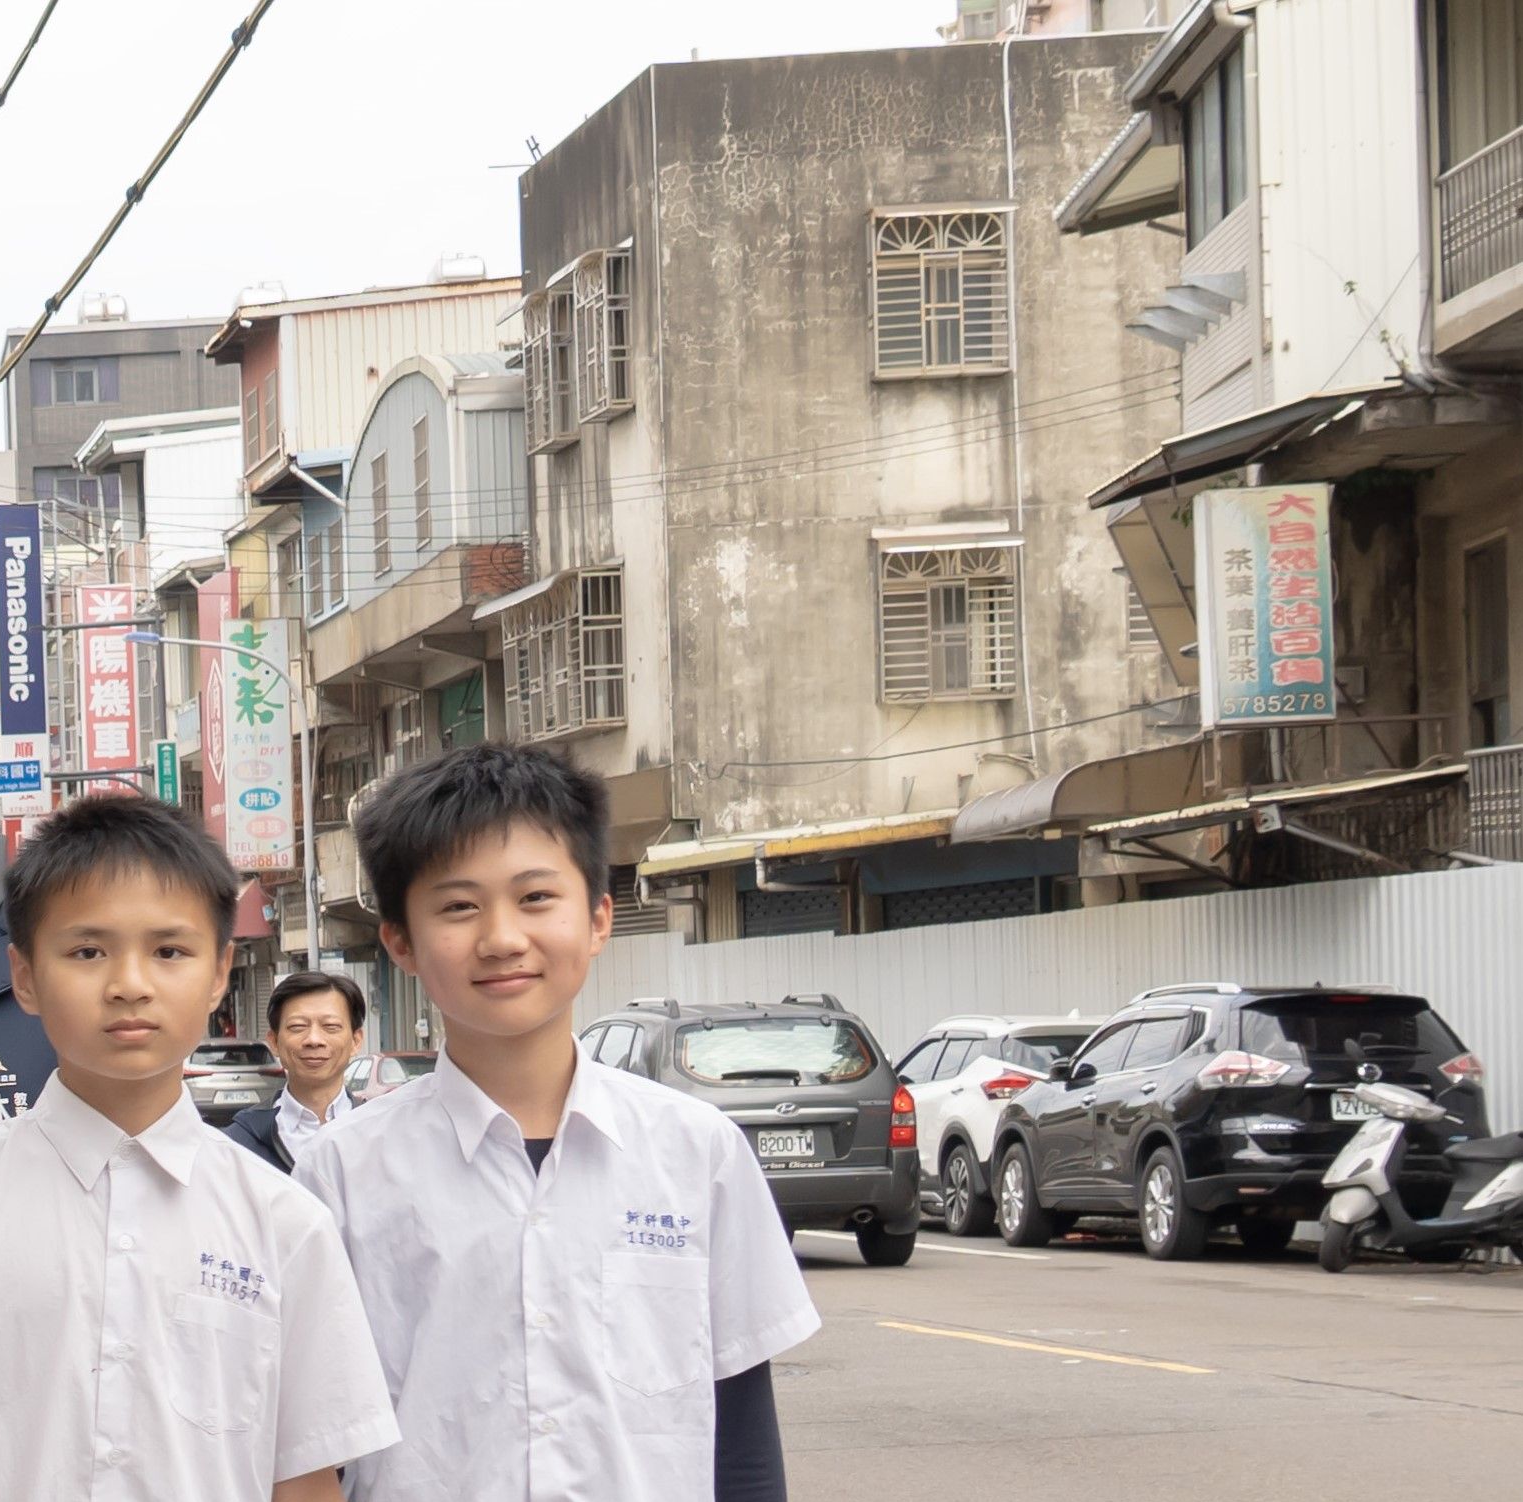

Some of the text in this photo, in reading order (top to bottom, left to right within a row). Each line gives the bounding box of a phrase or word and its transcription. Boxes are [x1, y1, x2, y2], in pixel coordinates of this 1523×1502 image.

[4, 536, 35, 703] Panasonic
[1223, 693, 1327, 715] 5785278
[627, 1231, 687, 1248] 113005
[200, 1270, 261, 1304] 113057
